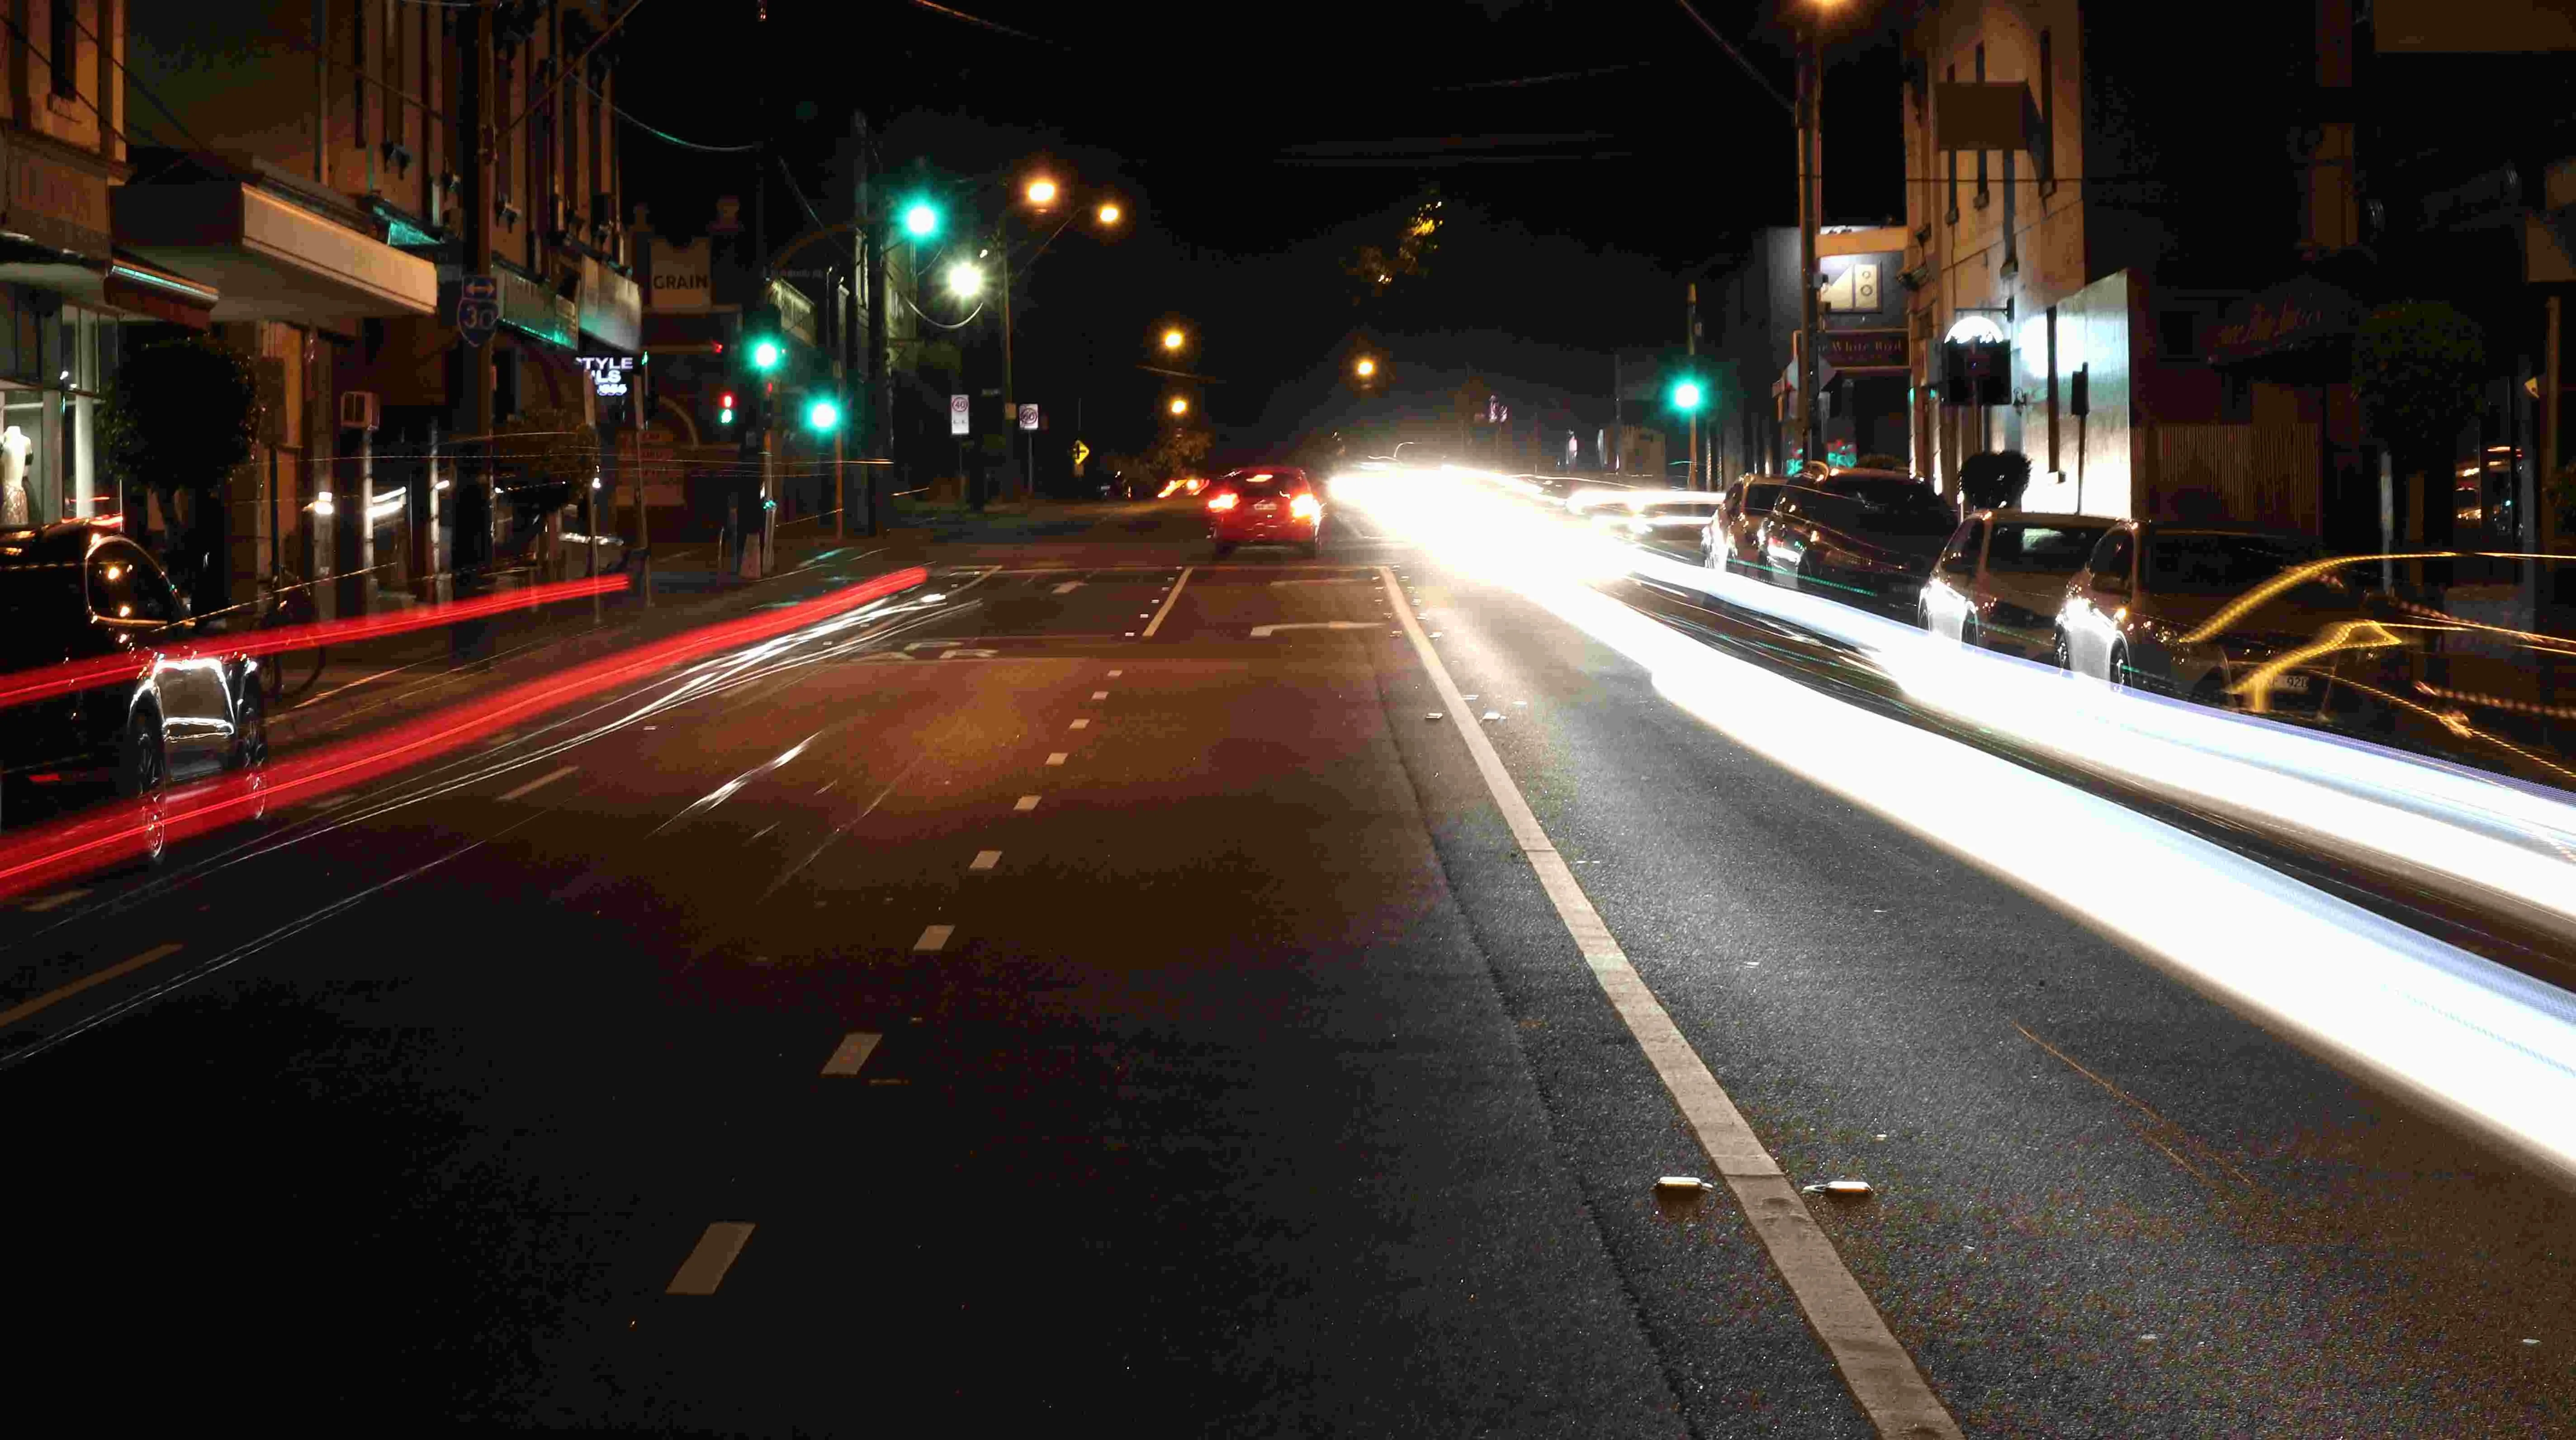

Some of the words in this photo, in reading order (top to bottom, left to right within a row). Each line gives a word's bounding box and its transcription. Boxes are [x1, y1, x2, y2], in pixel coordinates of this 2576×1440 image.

[654, 275, 708, 289] GRAIN
[463, 305, 495, 330] 30
[955, 400, 966, 408] 40
